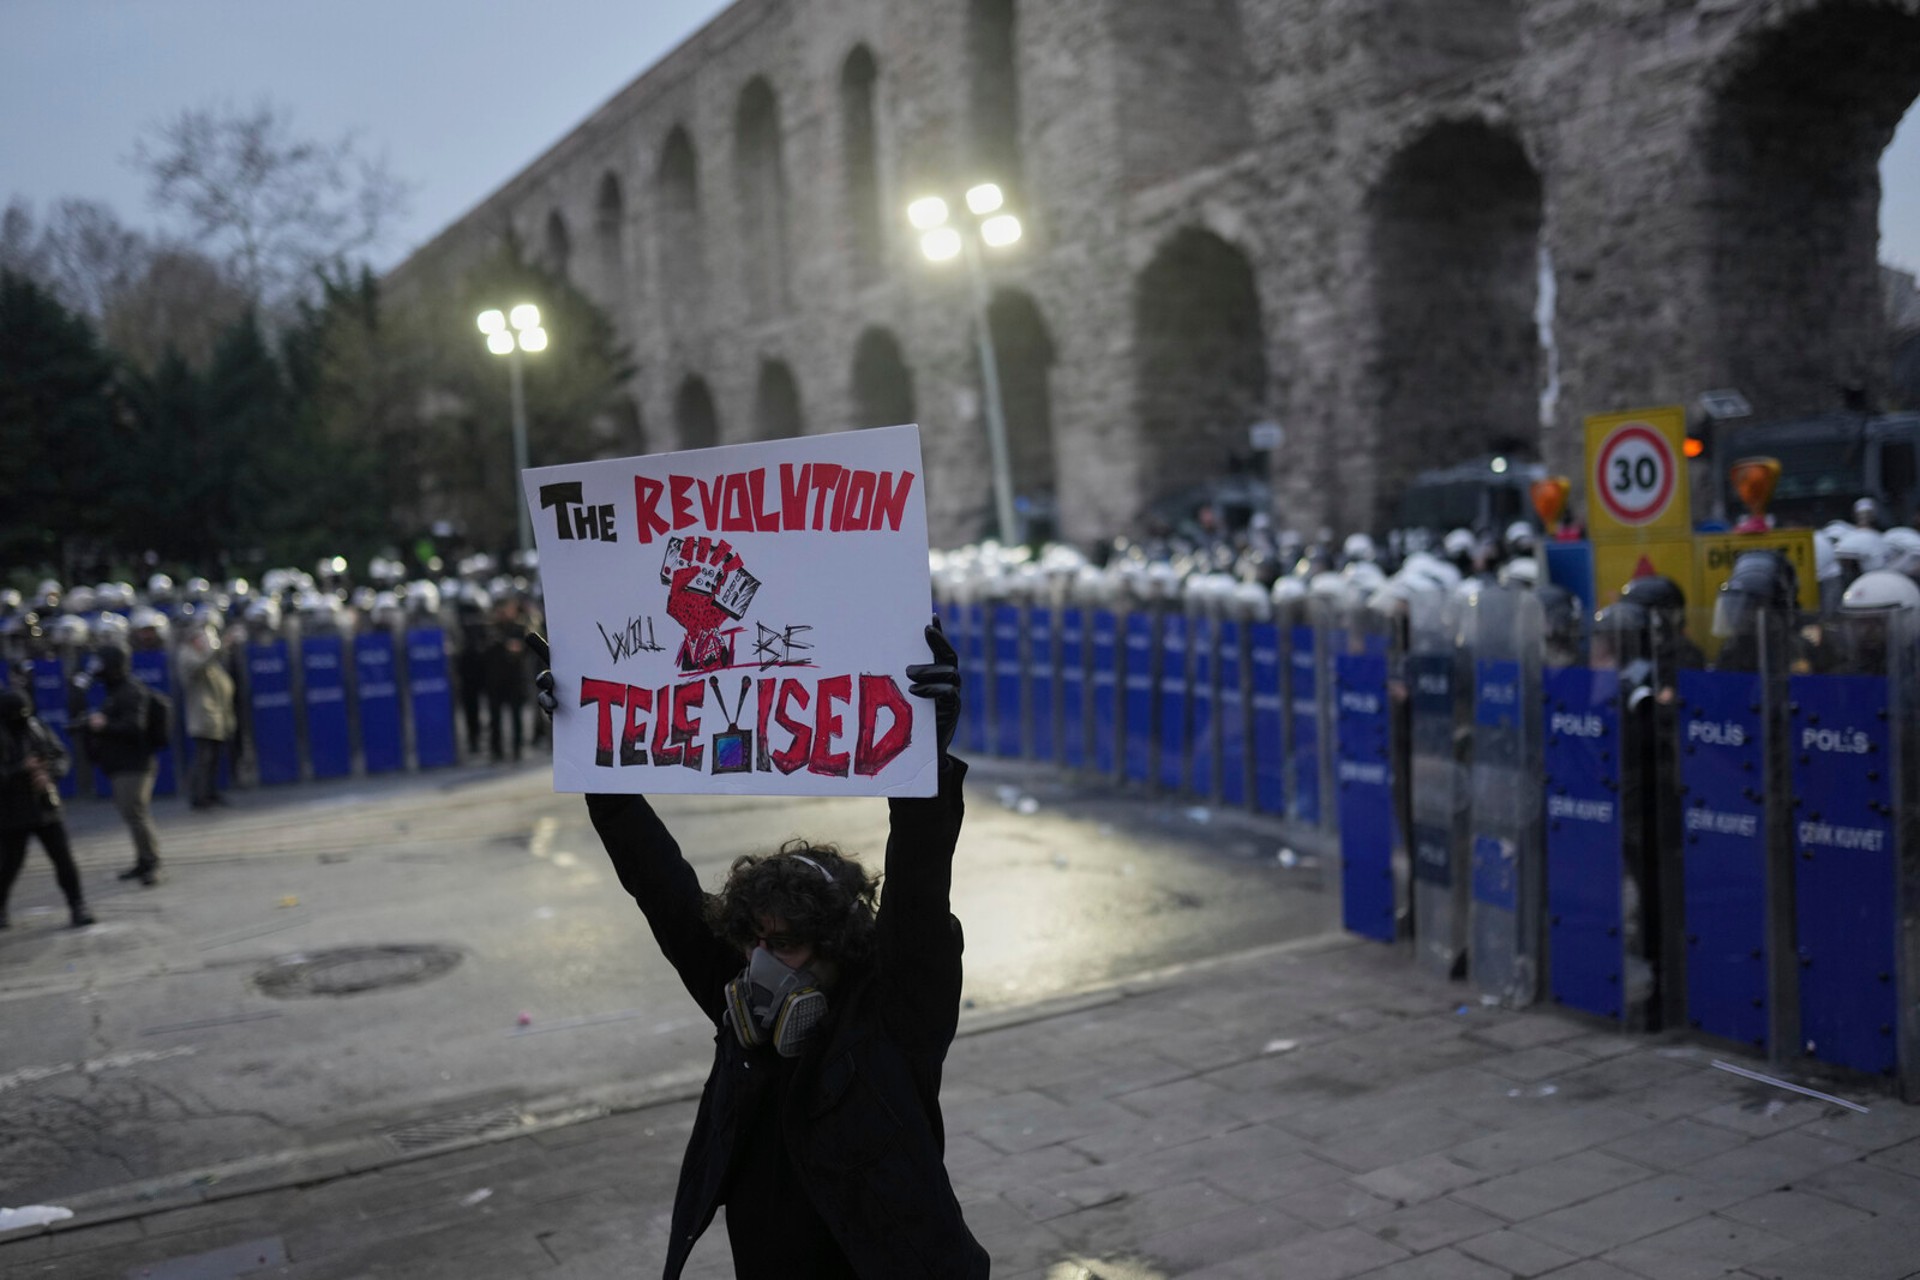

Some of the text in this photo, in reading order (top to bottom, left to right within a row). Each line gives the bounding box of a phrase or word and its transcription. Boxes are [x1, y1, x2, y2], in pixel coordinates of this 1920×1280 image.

[539, 463, 916, 544] THE REVOLUTION
[1613, 457, 1658, 492] 30
[596, 615, 667, 665] WILL
[752, 620, 815, 673] BE
